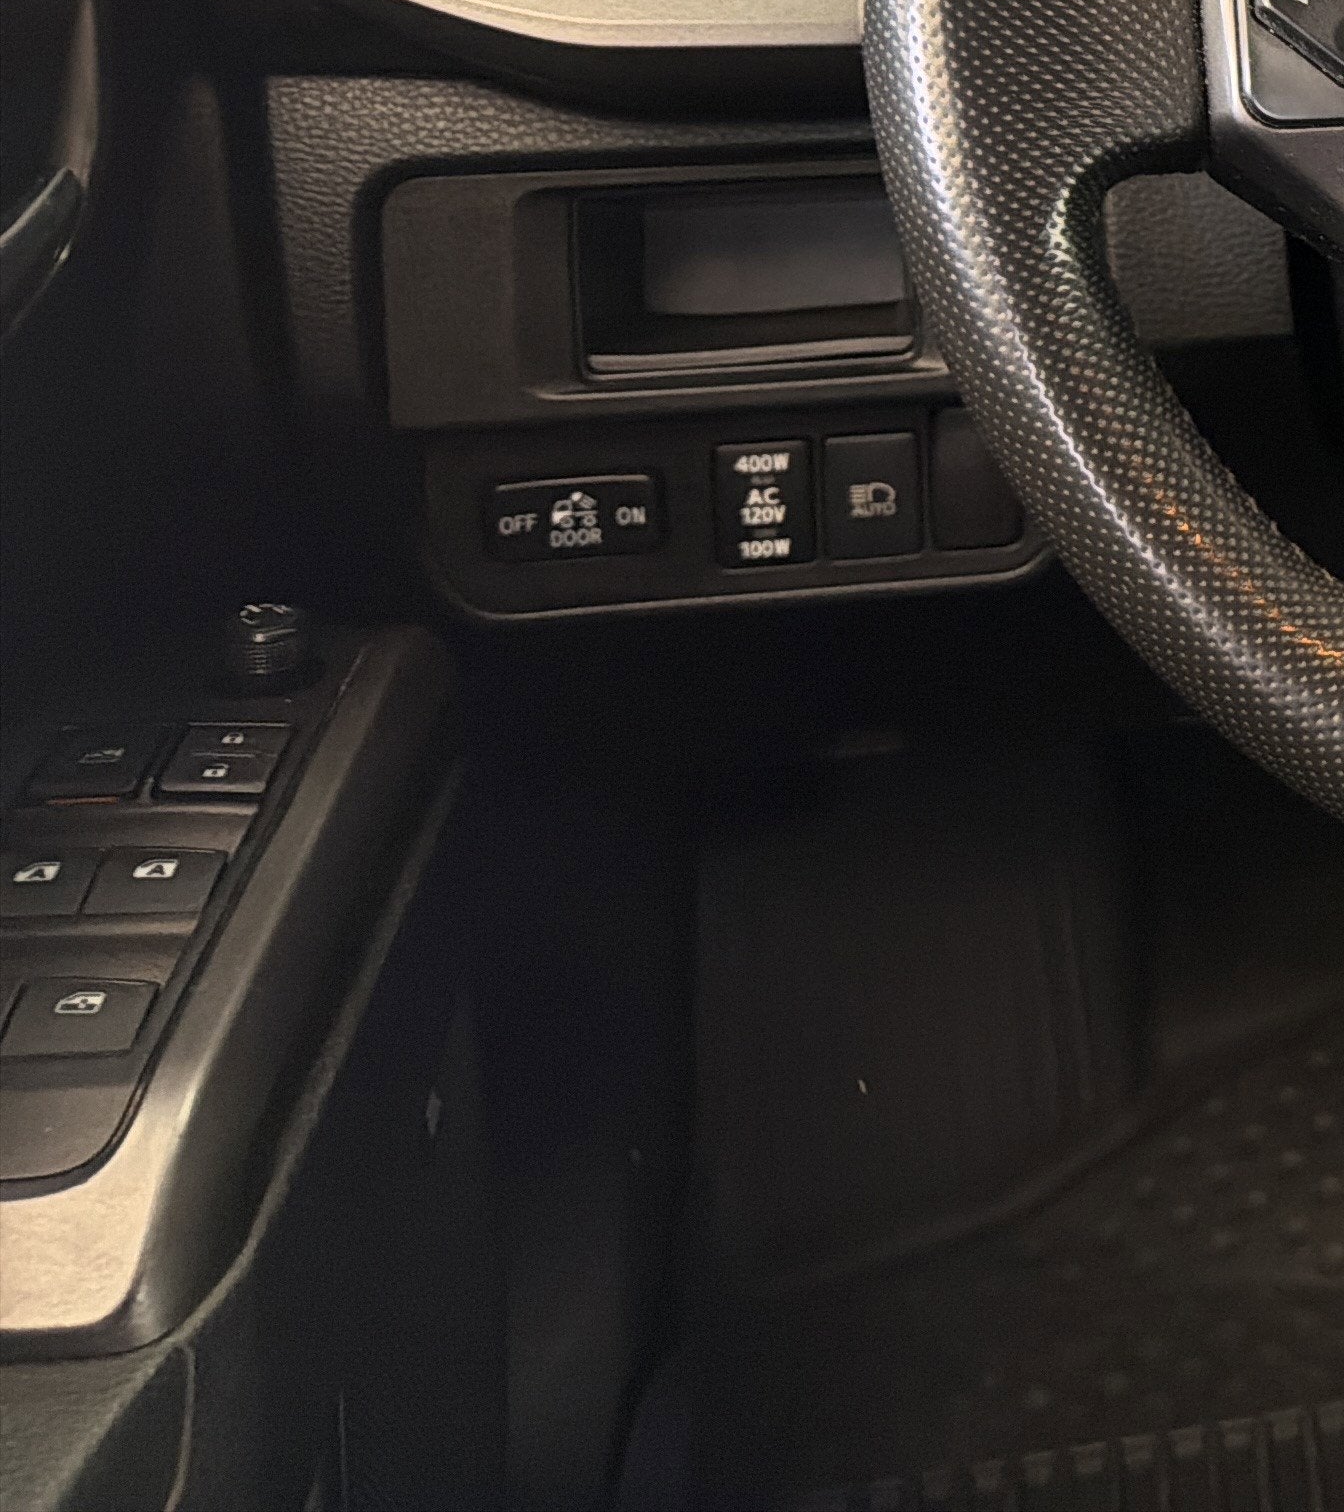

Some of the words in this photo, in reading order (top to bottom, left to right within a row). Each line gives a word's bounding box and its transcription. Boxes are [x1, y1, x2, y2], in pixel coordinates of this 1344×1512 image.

[733, 453, 790, 474] 400W
[746, 487, 780, 506] AC
[615, 506, 646, 526] ON
[740, 504, 786, 527] 120V
[851, 500, 896, 519] AUTO
[499, 513, 538, 535] OFF
[550, 528, 601, 548] DOOR
[737, 538, 792, 560] 100W
